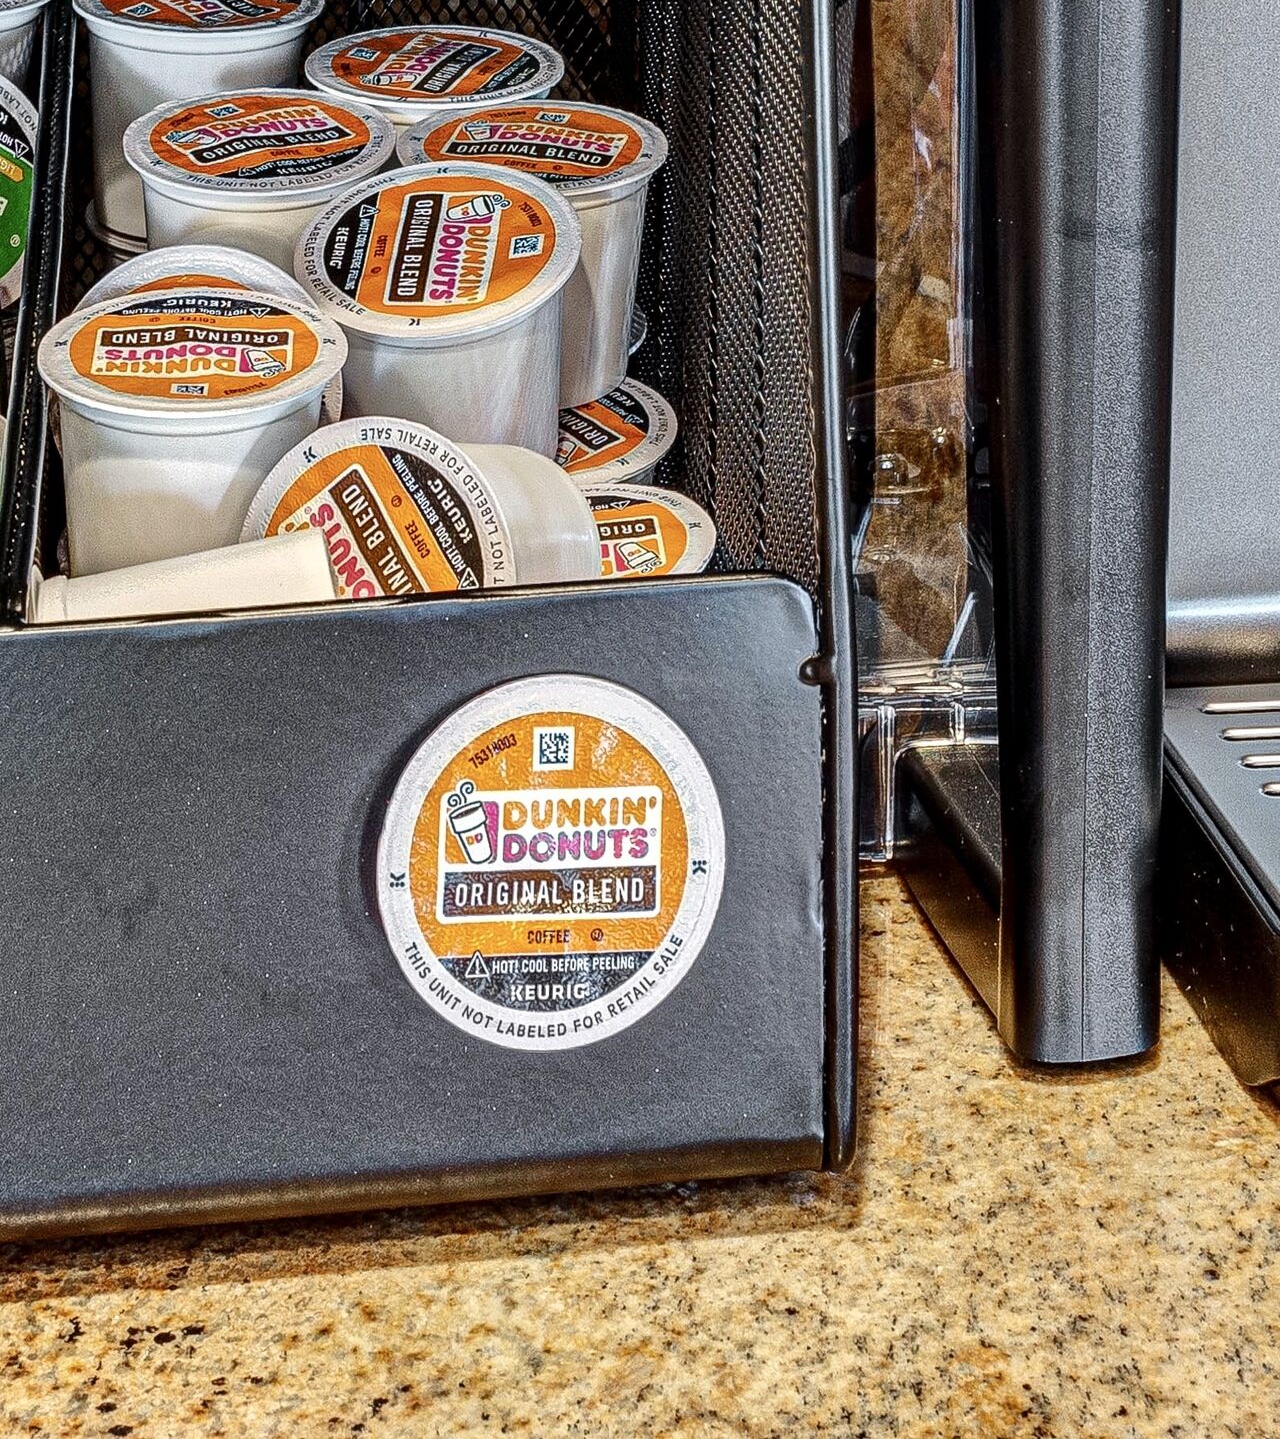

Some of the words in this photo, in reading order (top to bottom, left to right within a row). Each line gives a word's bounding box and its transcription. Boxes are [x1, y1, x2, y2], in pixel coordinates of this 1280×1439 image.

[219, 117, 328, 138] DONUTS
[499, 132, 612, 152] DONUTS
[503, 123, 623, 144] DUNKIN'
[203, 135, 282, 159] ORIGINAL
[285, 130, 339, 145] BLEND
[456, 145, 537, 156] ORIGINAL
[546, 148, 602, 164] BLEND
[407, 199, 433, 257] ORIGINAL
[330, 227, 350, 269] KEURIG
[398, 255, 421, 296] BLEND
[455, 226, 486, 302] DUNKIN'
[162, 298, 232, 308] KEURIG
[310, 277, 335, 304] RETAIL
[336, 298, 365, 316] SALE
[112, 329, 174, 343] BLEND
[185, 328, 278, 344] ORIGINAL
[96, 357, 236, 374] DUNKIN'
[103, 344, 236, 360] DONUTS
[361, 427, 392, 441] SALE
[398, 429, 439, 456] RETAIL
[392, 455, 419, 492] PEELING
[439, 452, 465, 475] FOR
[342, 484, 385, 547] BLEND
[427, 479, 472, 544] KEURIG
[462, 475, 498, 536] LABELED
[310, 504, 375, 599] ONUTS
[405, 520, 431, 559] COFFEE
[492, 541, 504, 571] NOT
[502, 796, 658, 829] DUNKIN'
[455, 880, 563, 907] ORIGINAL
[572, 877, 644, 903] BLEND
[527, 930, 570, 943] COFFEE
[492, 960, 520, 974] HOT!
[522, 959, 548, 973] COOL
[551, 958, 590, 971] BEFORE
[592, 957, 635, 970] PEELING
[405, 941, 431, 978] THIS
[428, 978, 461, 1009] UNIT
[462, 1005, 493, 1029] NOT
[496, 1018, 567, 1039] LABELED
[573, 1010, 604, 1031] FOR
[607, 977, 656, 1017] RETAIL
[657, 934, 684, 974] SALE
[510, 984, 589, 1001] KEURIG
